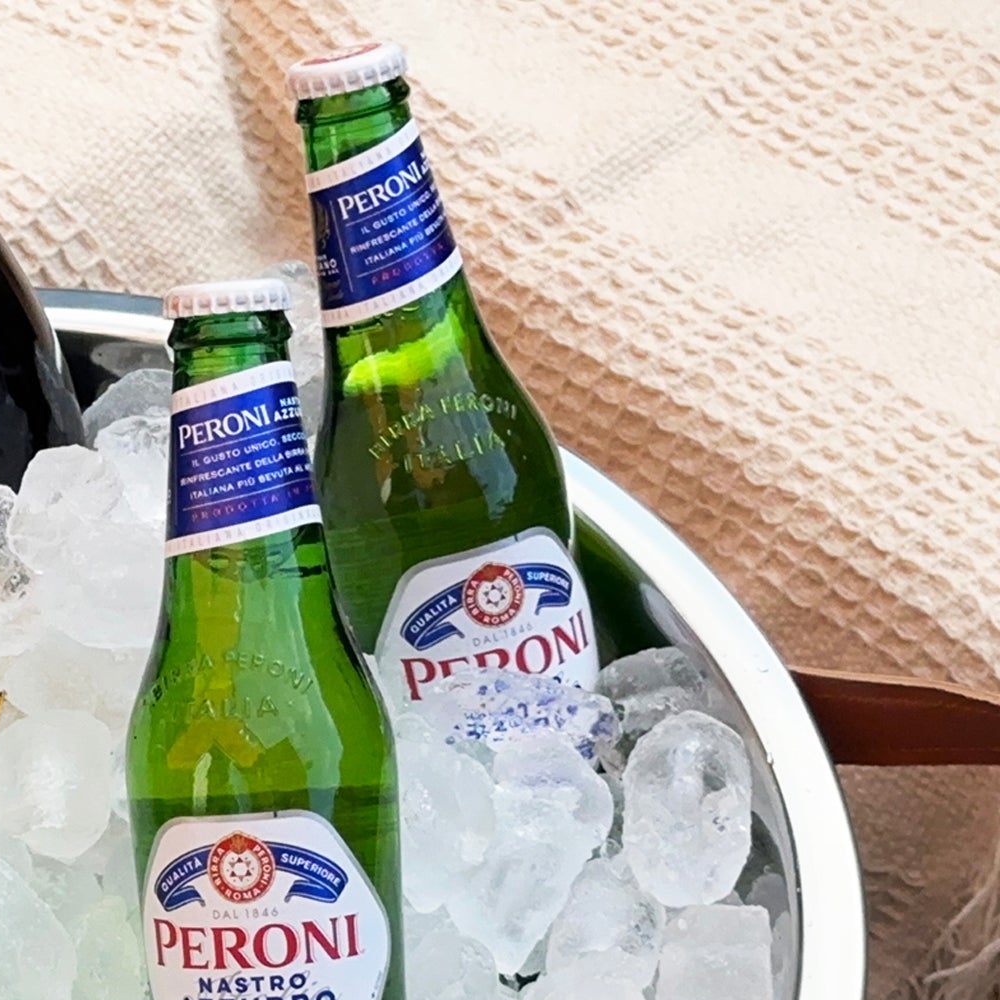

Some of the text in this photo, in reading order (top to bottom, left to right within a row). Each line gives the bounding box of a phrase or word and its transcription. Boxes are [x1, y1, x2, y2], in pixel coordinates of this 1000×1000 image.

[337, 160, 422, 220] PERONI
[350, 217, 418, 255] RINFRESCANTE
[361, 225, 370, 234] IL
[372, 208, 407, 230] GUSTO
[364, 242, 408, 266] ITALIANA
[178, 404, 271, 450] PERONI
[180, 462, 252, 487] RINFRESCANTE
[254, 454, 284, 468] DELLA
[192, 459, 200, 467] IL
[203, 448, 240, 464] GUSTO
[190, 485, 234, 500] ITALIANA
[237, 477, 256, 489] PIÙ
[258, 465, 293, 483] BEVUTA
[410, 593, 458, 634] QUALITÀ
[482, 608, 517, 625] ROMA
[473, 622, 534, 647] DAL 1846
[161, 856, 202, 893] QUALITÀ
[210, 843, 272, 901] BIRRA PERONI ROMA
[281, 852, 341, 887] SUPERIORE
[212, 906, 279, 920] DAL 1846
[153, 913, 361, 971] PERONI
[199, 973, 307, 994] NASTRO
